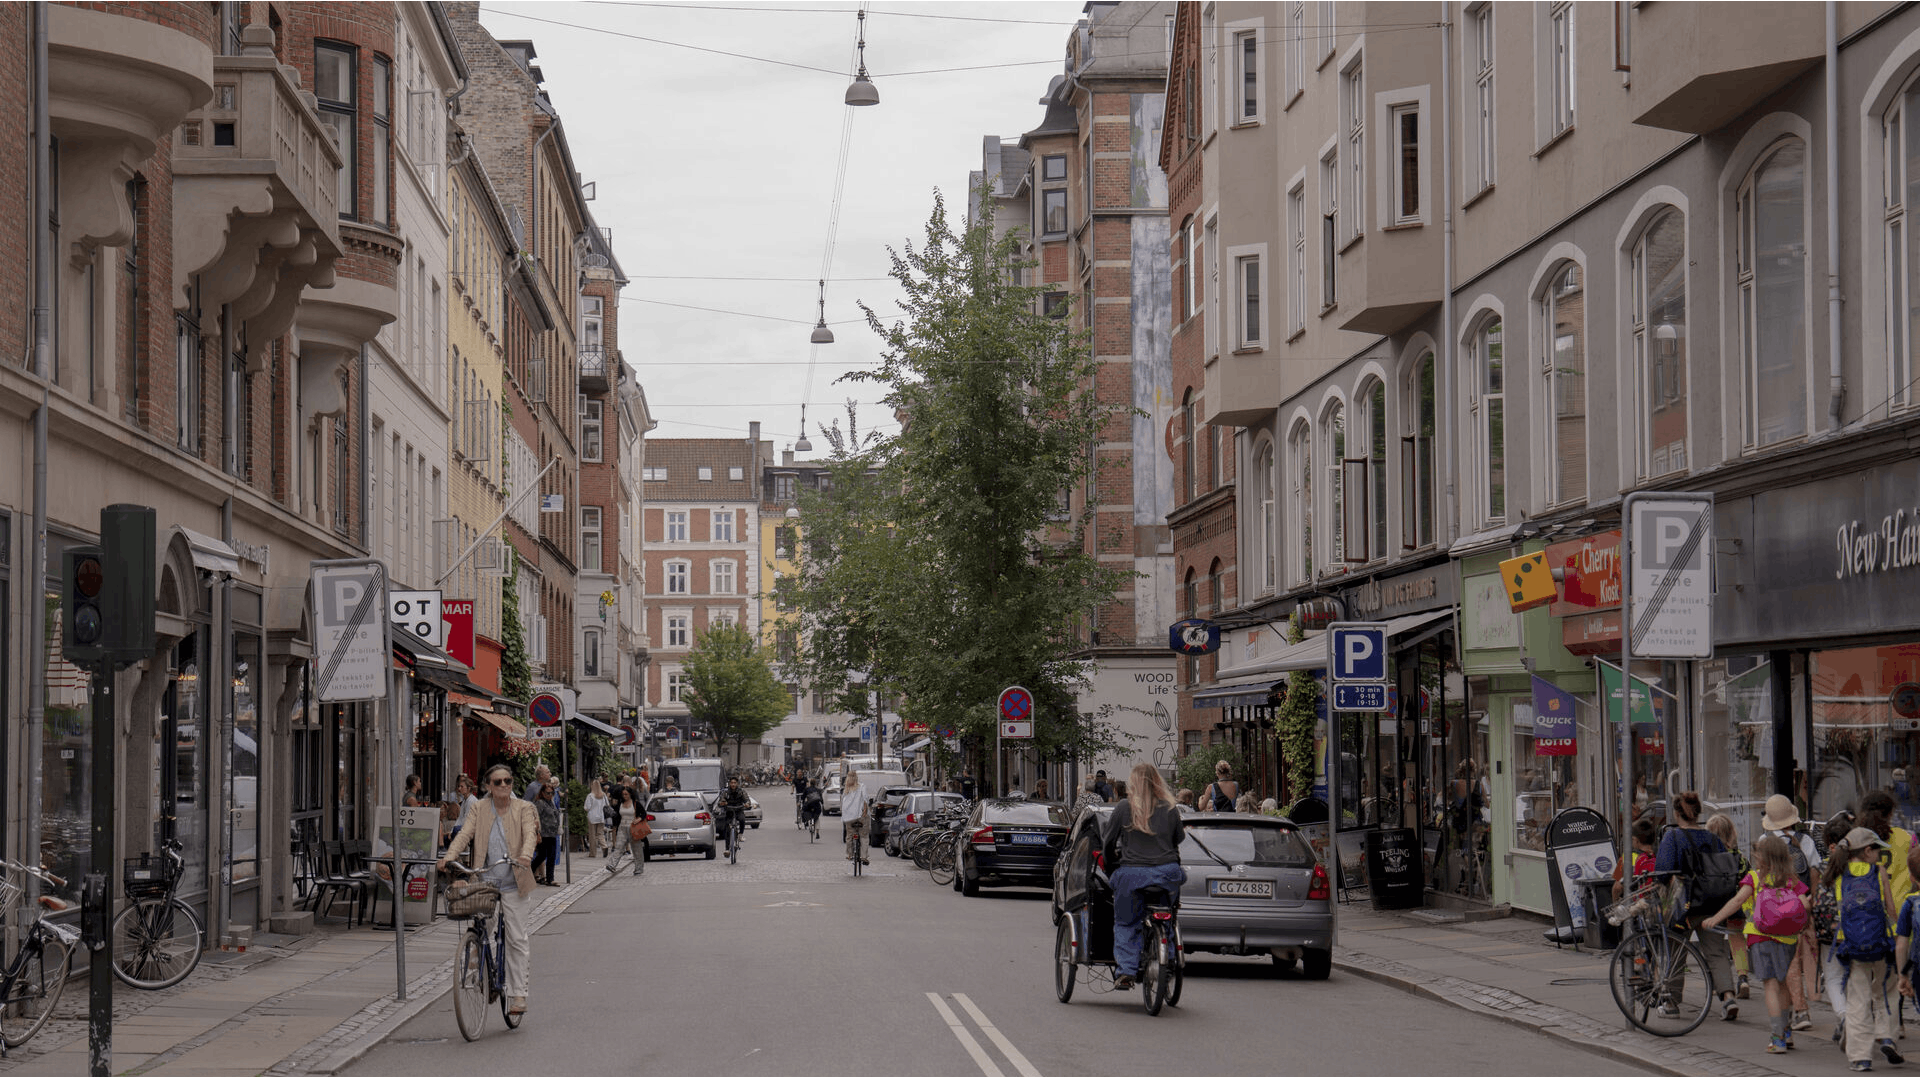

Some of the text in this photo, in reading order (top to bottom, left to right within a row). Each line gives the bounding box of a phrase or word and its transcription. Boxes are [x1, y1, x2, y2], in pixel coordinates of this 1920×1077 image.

[1656, 517, 1689, 563] P
[1837, 520, 1877, 579] New
[1582, 543, 1614, 579] Cherry
[1651, 574, 1692, 587] Zne
[1600, 578, 1620, 603] Kiosk
[335, 580, 364, 621] P
[332, 630, 367, 641] Zne
[1345, 634, 1374, 674] P
[1134, 673, 1174, 683] WOOD
[1148, 685, 1169, 695] Life
[1536, 715, 1572, 728] QUICK
[1562, 825, 1595, 834] company
[1567, 820, 1588, 828] water
